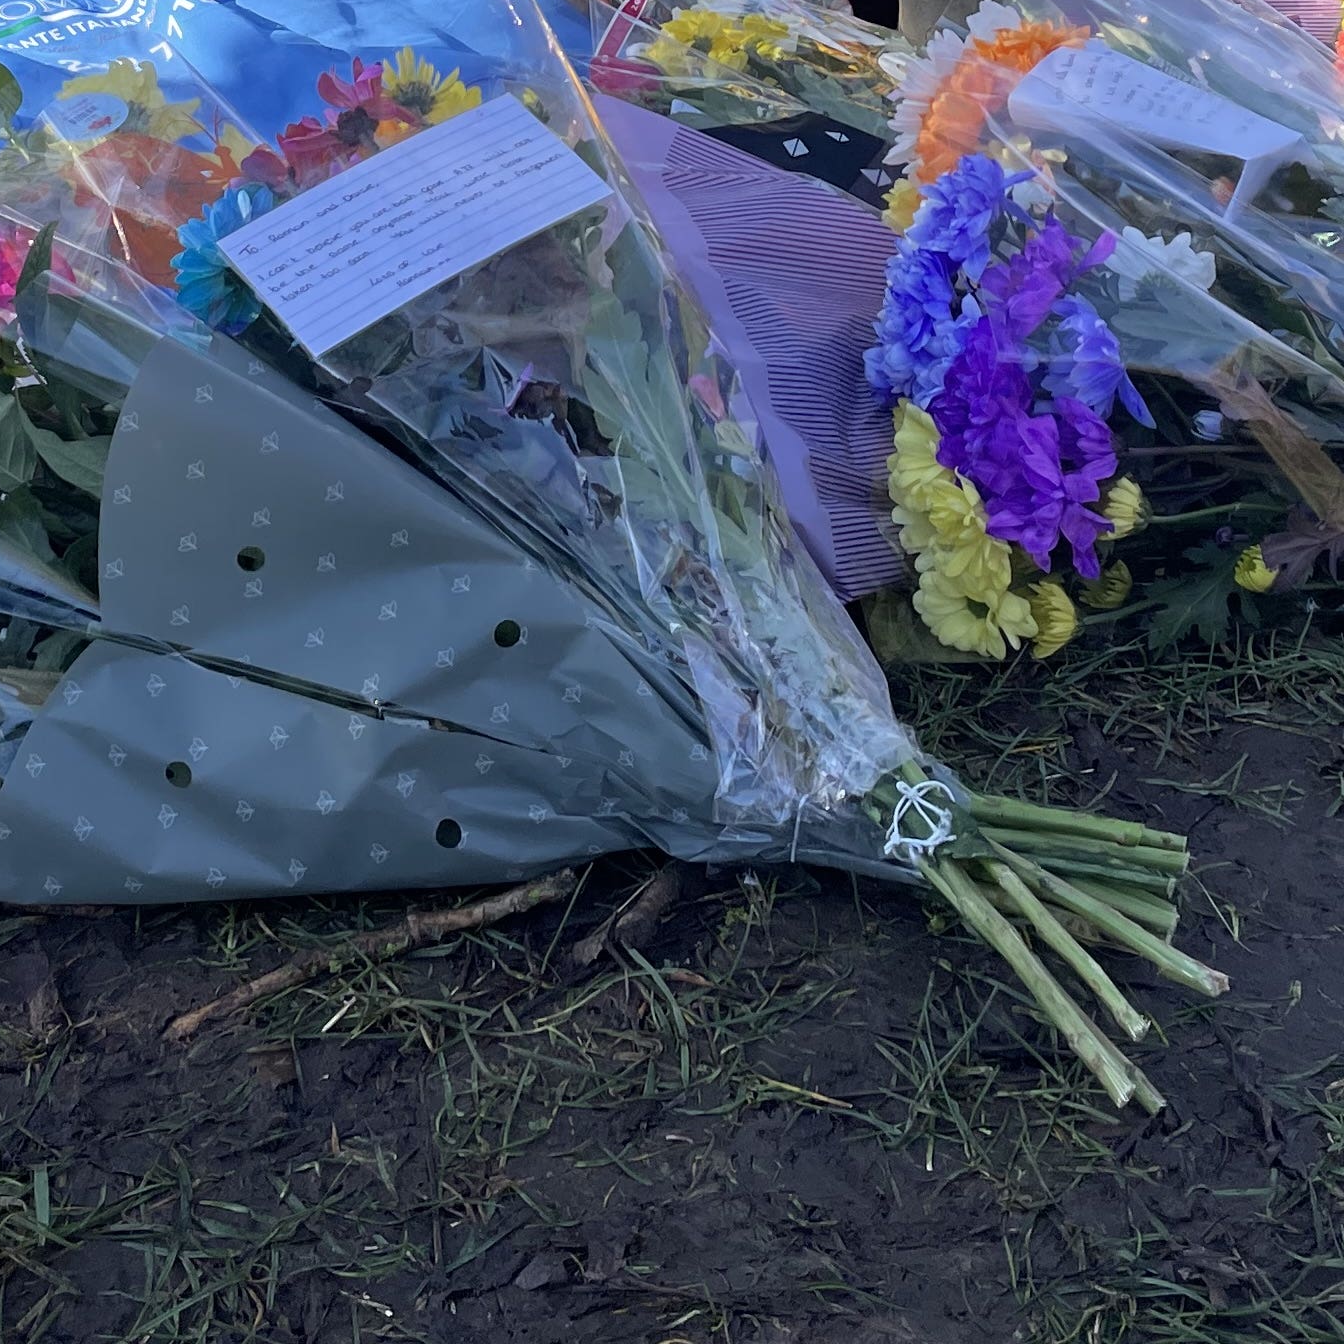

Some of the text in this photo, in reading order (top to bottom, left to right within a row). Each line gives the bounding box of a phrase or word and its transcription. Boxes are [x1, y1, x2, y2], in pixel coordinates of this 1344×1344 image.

[316, 203, 339, 218] and
[268, 256, 300, 277] can't
[350, 218, 370, 233] you
[372, 207, 391, 219] are
[368, 270, 396, 287] Lots
[421, 242, 444, 256] love
[268, 280, 288, 293] be
[294, 263, 316, 278] the
[328, 239, 360, 258] same
[280, 282, 314, 302] taken
[320, 267, 341, 280] too
